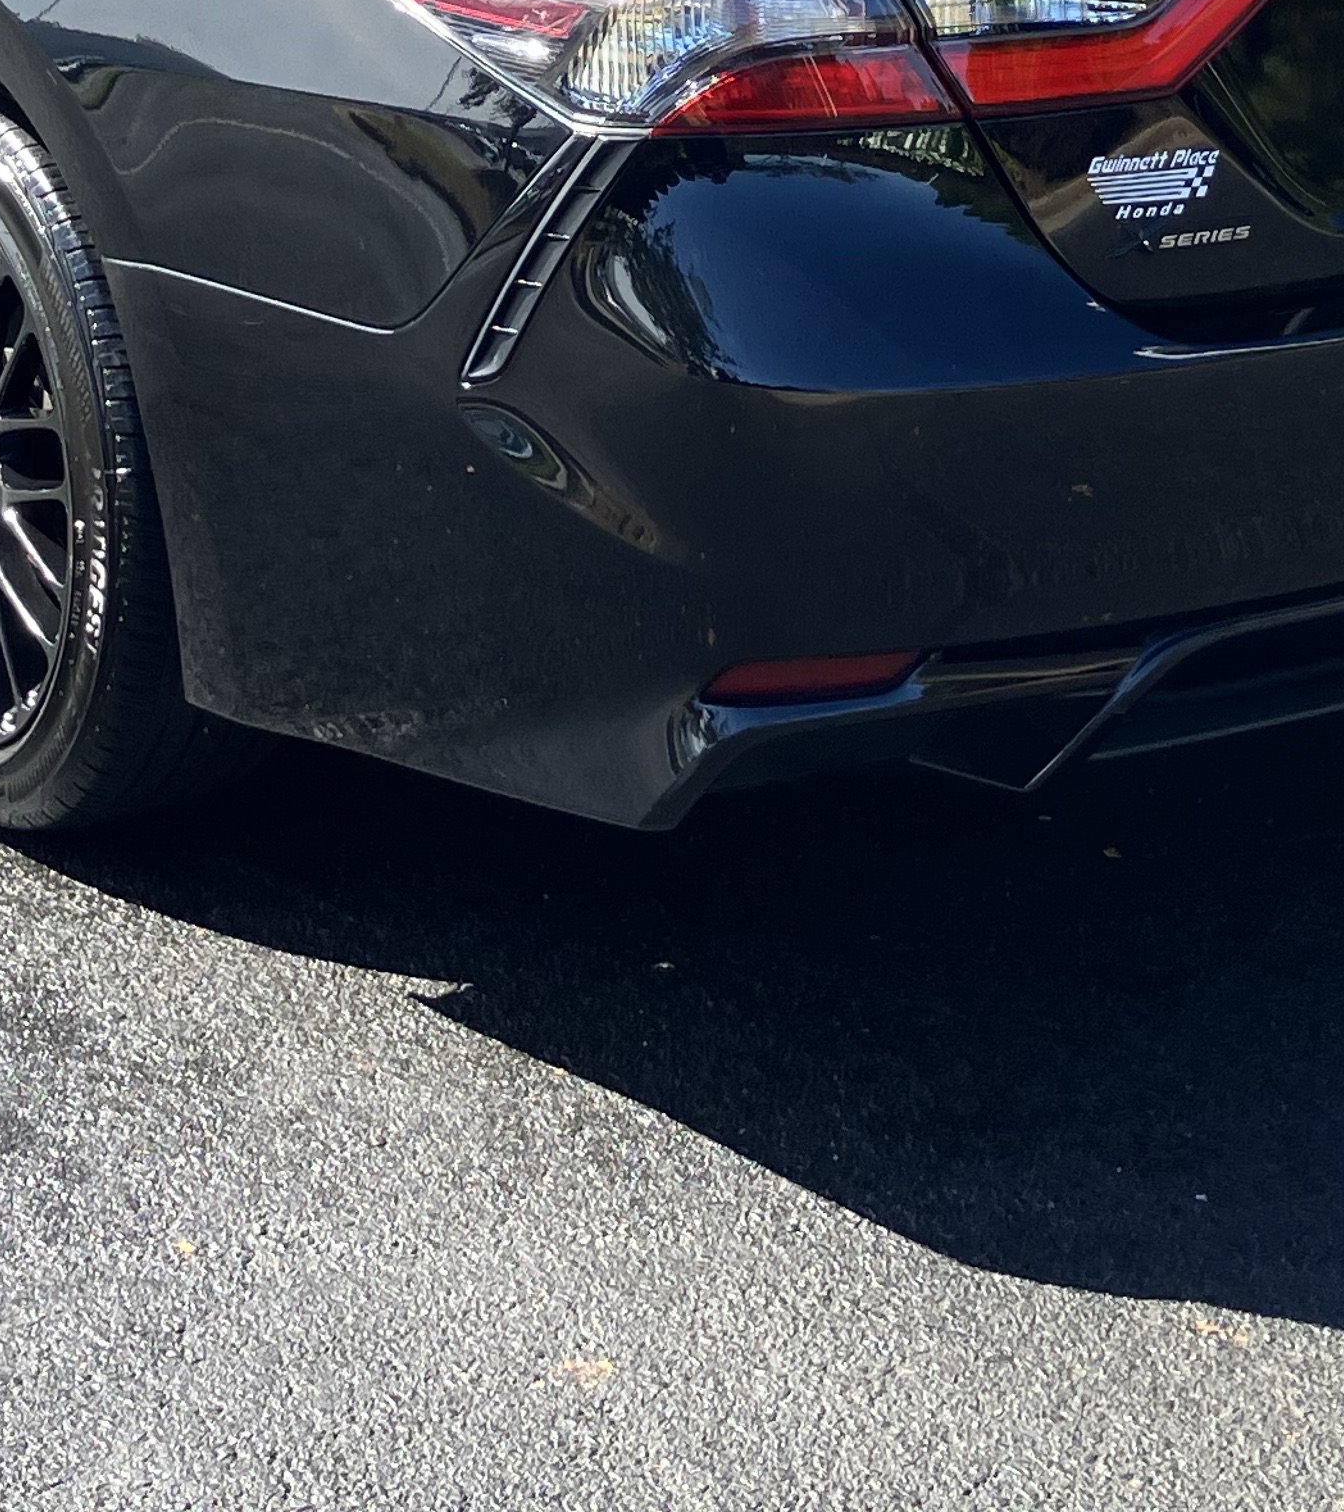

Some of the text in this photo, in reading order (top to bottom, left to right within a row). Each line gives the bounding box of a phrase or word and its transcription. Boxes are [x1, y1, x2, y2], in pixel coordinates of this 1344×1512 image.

[1087, 148, 1221, 174] Gwinnett Place
[1115, 201, 1186, 221] Honda
[1158, 224, 1252, 250] SERIES
